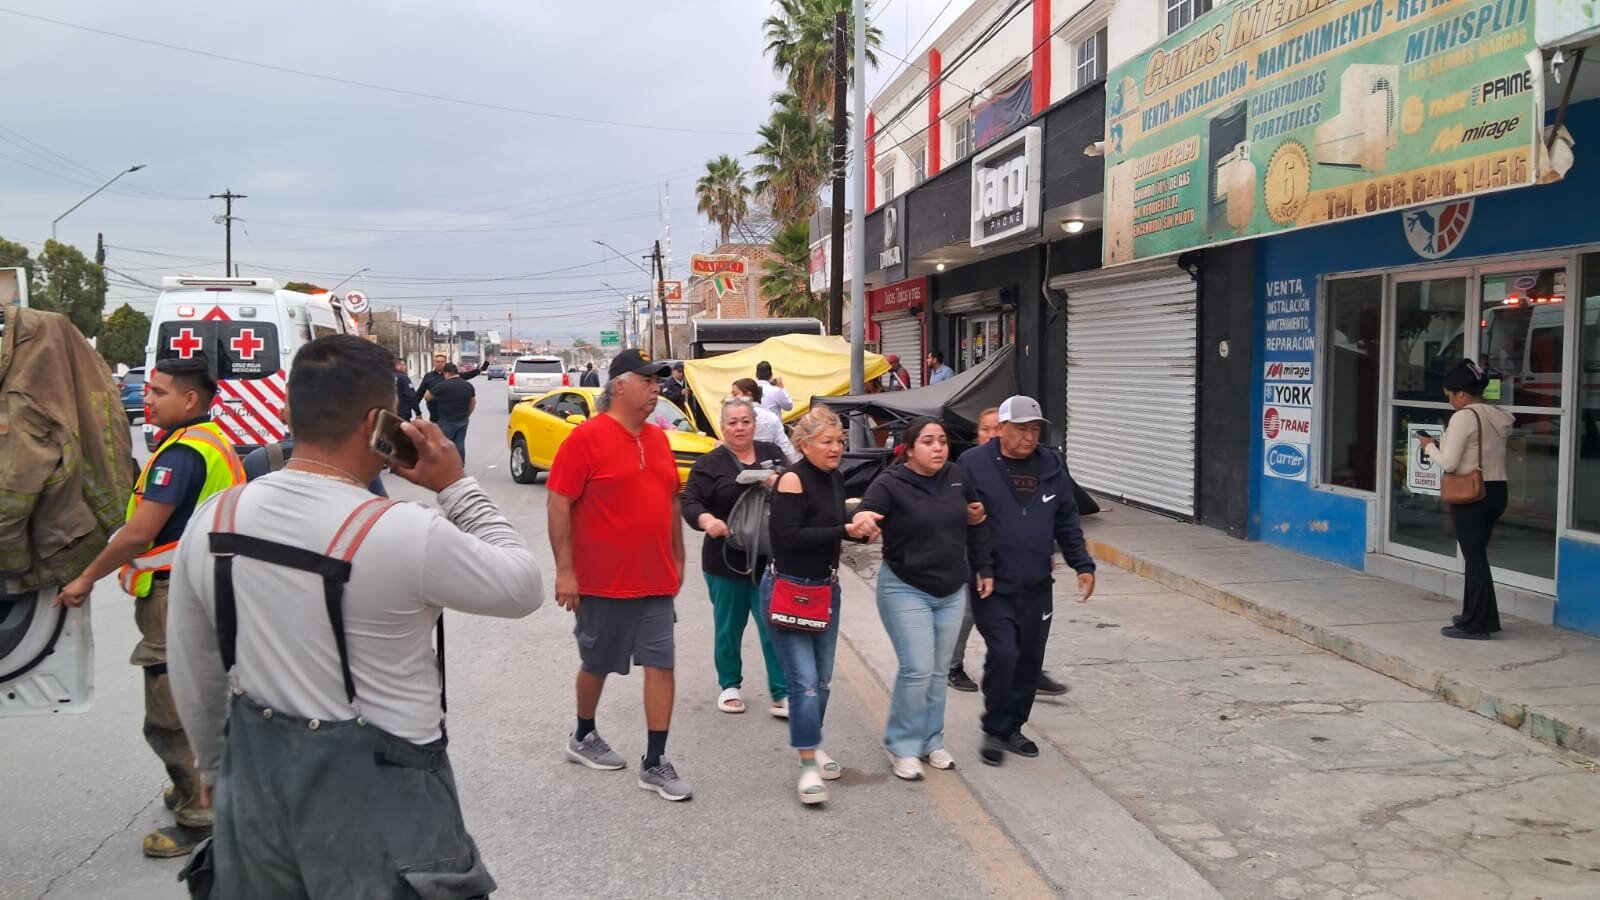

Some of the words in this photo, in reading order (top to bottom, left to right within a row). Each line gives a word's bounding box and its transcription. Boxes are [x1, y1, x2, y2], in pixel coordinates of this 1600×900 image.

[1256, 0, 1384, 81] MANTENIMIENTO
[1144, 24, 1224, 97] CLIMAS
[1431, 47, 1476, 76] MEJORES
[1479, 31, 1529, 57] MARCAS
[1251, 69, 1328, 118] CALENTADORES
[1483, 69, 1533, 103] PRIME
[1252, 101, 1323, 142] PORTÁTILES
[1461, 115, 1521, 143] mirage
[1178, 169, 1191, 188] GAS
[1365, 152, 1527, 213] 866.648.1456
[990, 210, 1021, 231] PHONE
[1283, 364, 1310, 378] mirage
[1276, 385, 1311, 405] YORK
[212, 408, 255, 417] LANCIA
[1280, 418, 1309, 434] TRANE
[1269, 450, 1303, 467] Carrier
[771, 613, 796, 624] POLO
[797, 618, 827, 628] SPORT
